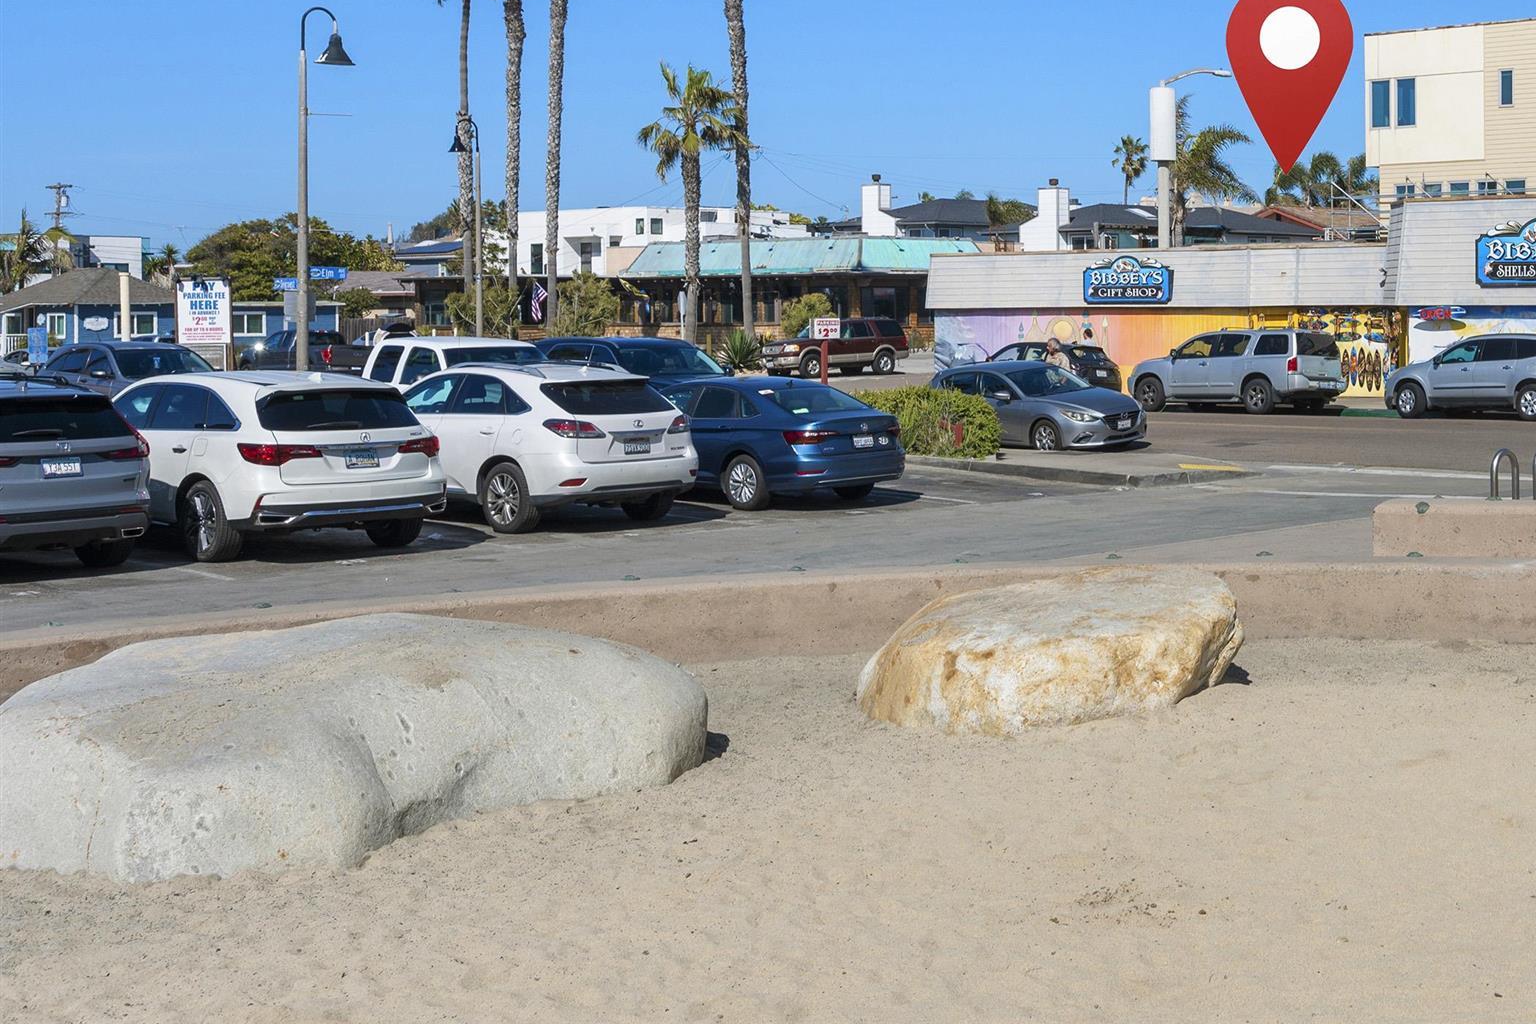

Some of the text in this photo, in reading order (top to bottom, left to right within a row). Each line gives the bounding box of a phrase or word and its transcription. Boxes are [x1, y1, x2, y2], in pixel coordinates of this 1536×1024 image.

[321, 269, 334, 278] Elm
[1496, 264, 1536, 277] SHELLS
[1090, 271, 1163, 285] BIBBEY'S
[1098, 287, 1157, 297] GIFT SHOP
[190, 300, 219, 310] HERE
